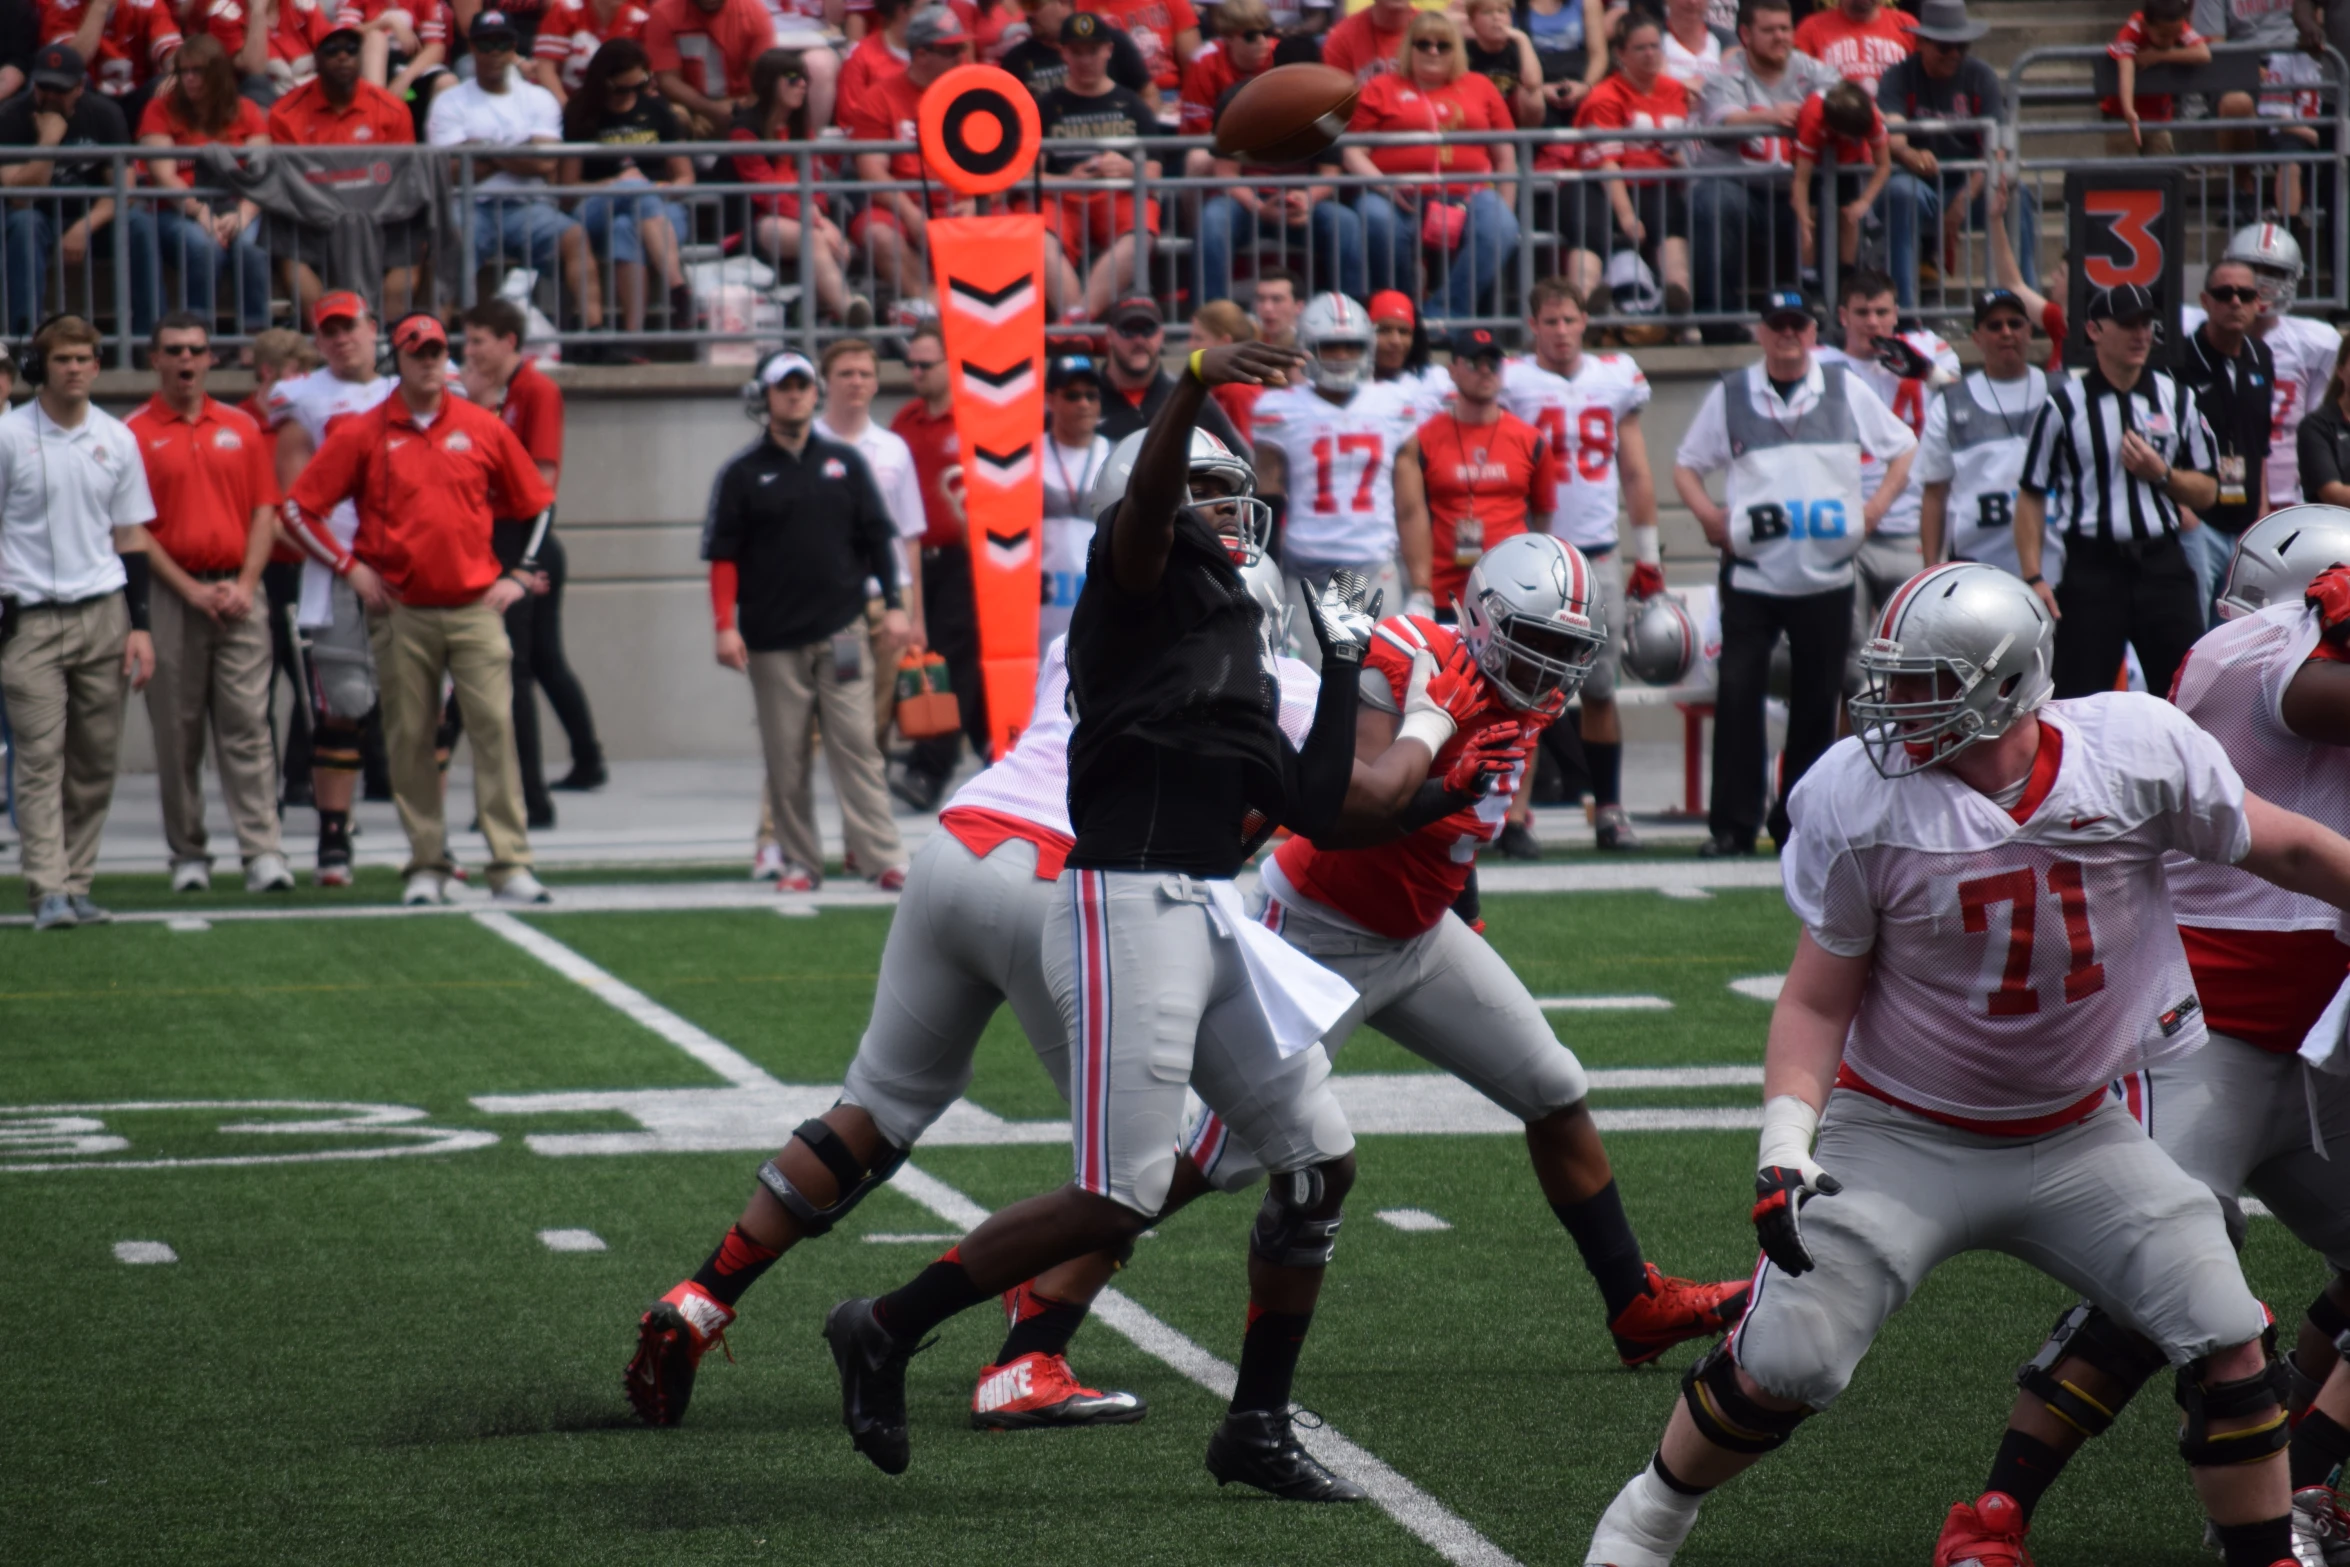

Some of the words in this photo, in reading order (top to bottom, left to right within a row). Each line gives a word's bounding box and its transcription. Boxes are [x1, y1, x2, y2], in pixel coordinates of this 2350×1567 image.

[2084, 190, 2163, 289] 3
[1310, 434, 1382, 515] 17
[1535, 406, 1615, 484] 48
[1560, 613, 1589, 628] Riddell
[1958, 861, 2105, 1016] 71
[679, 1293, 728, 1338] NIKE
[978, 1361, 1034, 1414] NIKE
